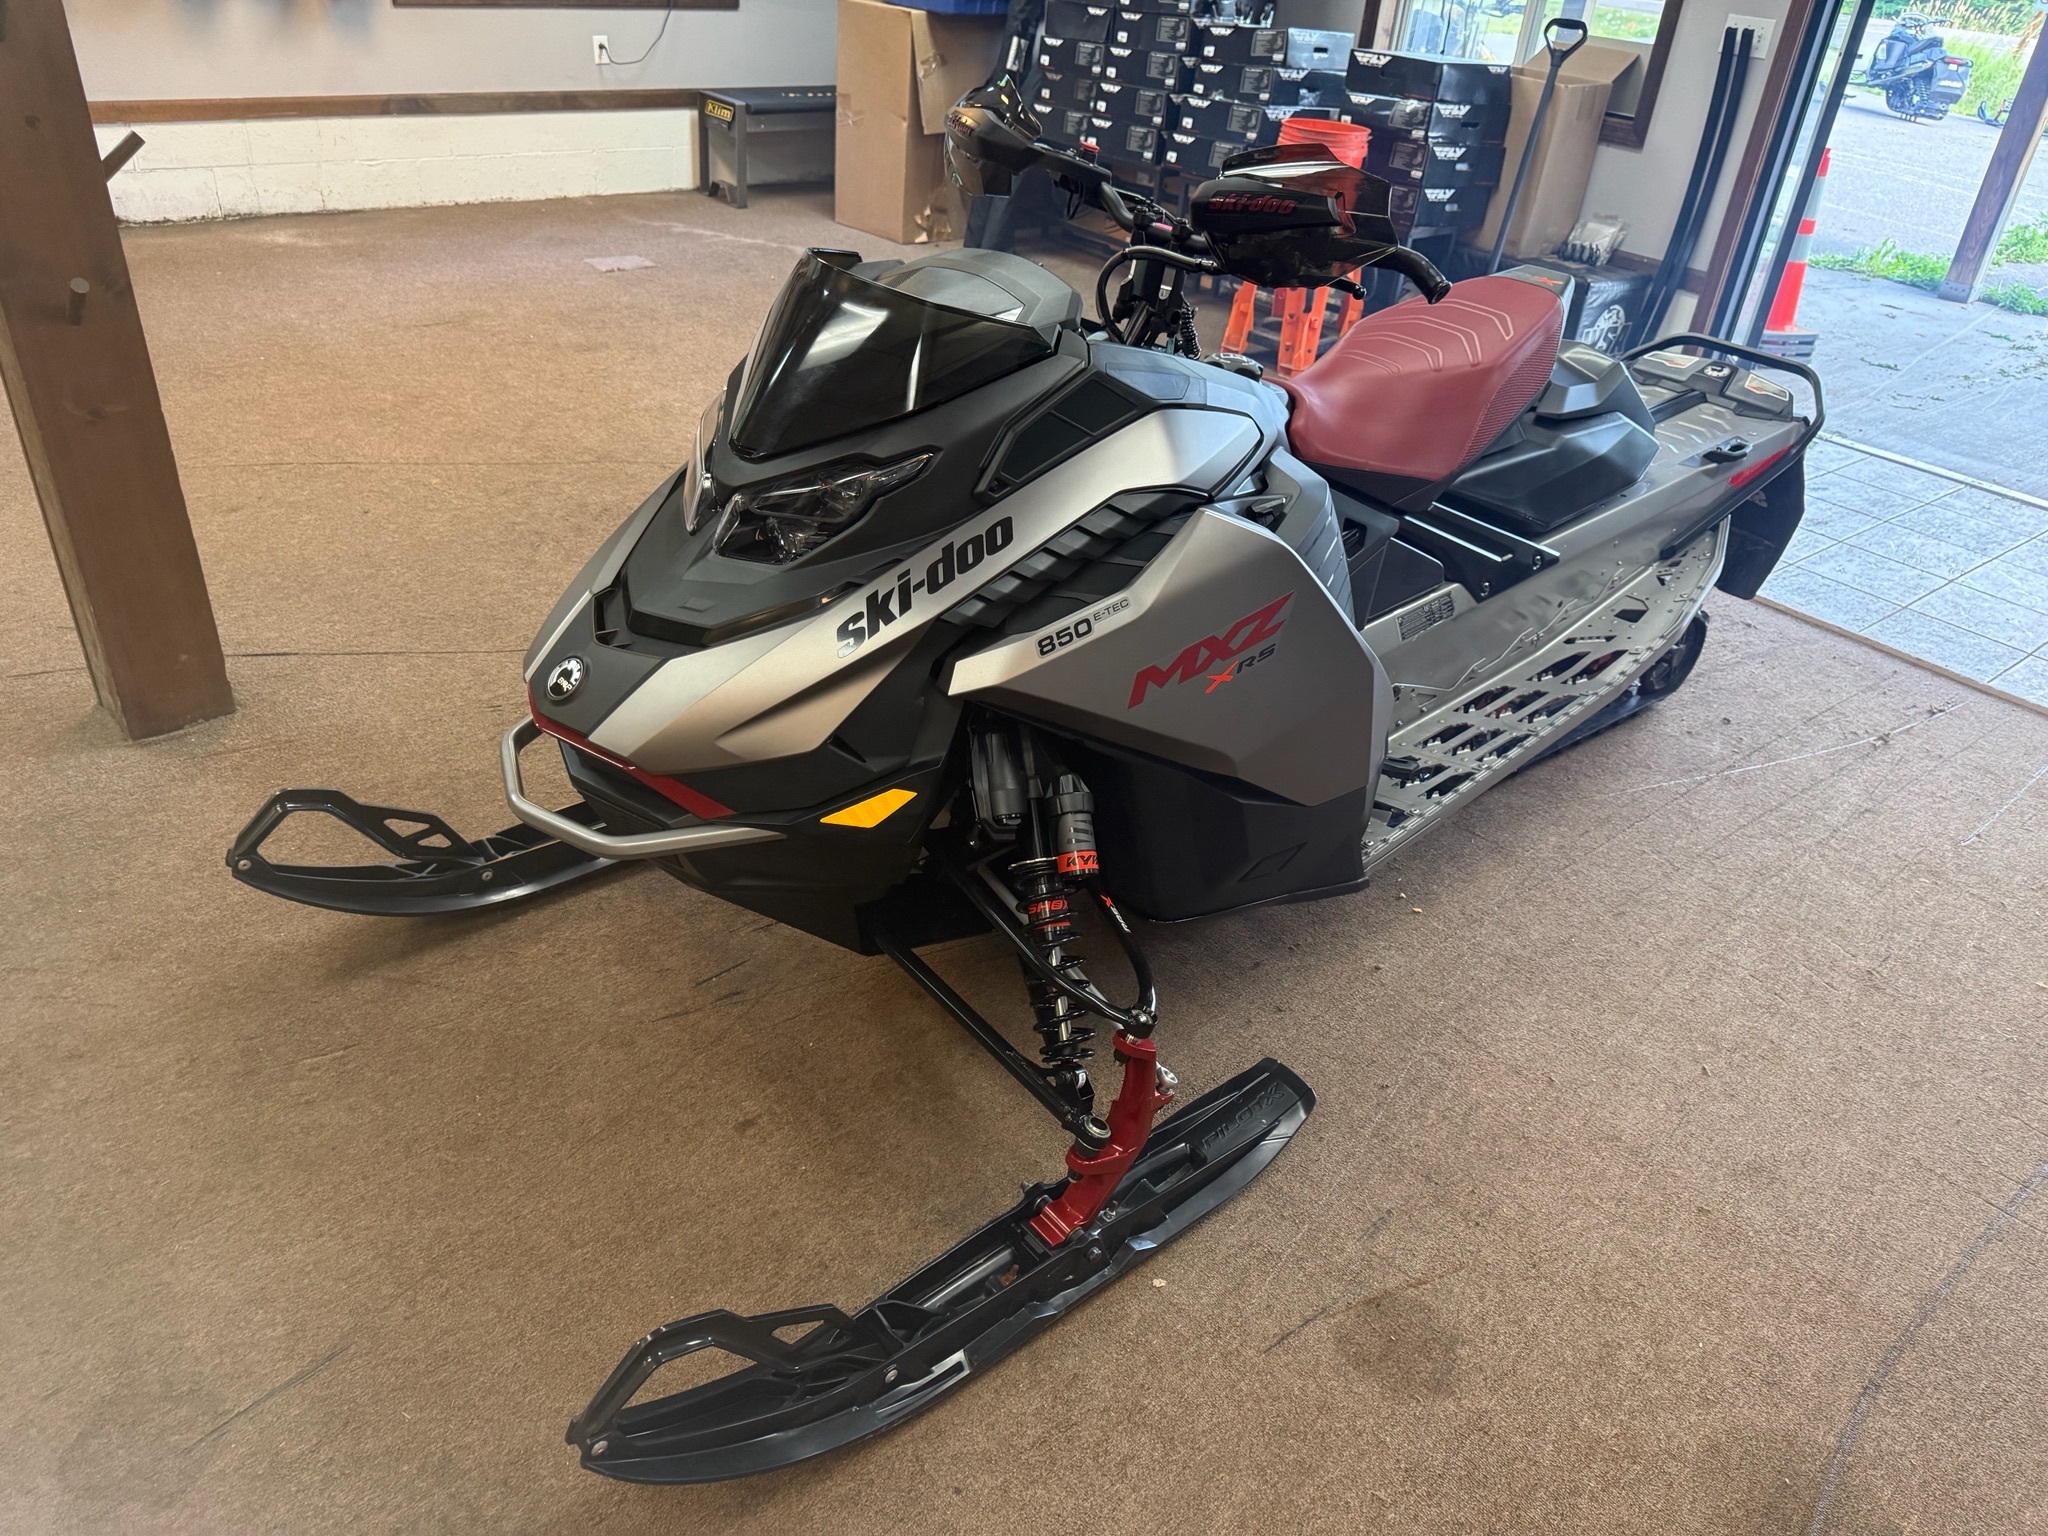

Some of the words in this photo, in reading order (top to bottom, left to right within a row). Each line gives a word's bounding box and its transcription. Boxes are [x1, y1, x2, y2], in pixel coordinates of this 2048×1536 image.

[1353, 51, 1393, 66] FLY
[1277, 69, 1311, 80] FLY
[707, 102, 732, 119] Klim
[1437, 104, 1472, 116] FLY
[1432, 146, 1467, 158] FLY
[1424, 188, 1456, 199] FLY
[1208, 194, 1298, 214] ski-doo
[836, 516, 1014, 658] ski-doo
[1038, 618, 1093, 656] 850
[1093, 599, 1130, 622] E-TEC
[1128, 590, 1295, 710] MXZ
